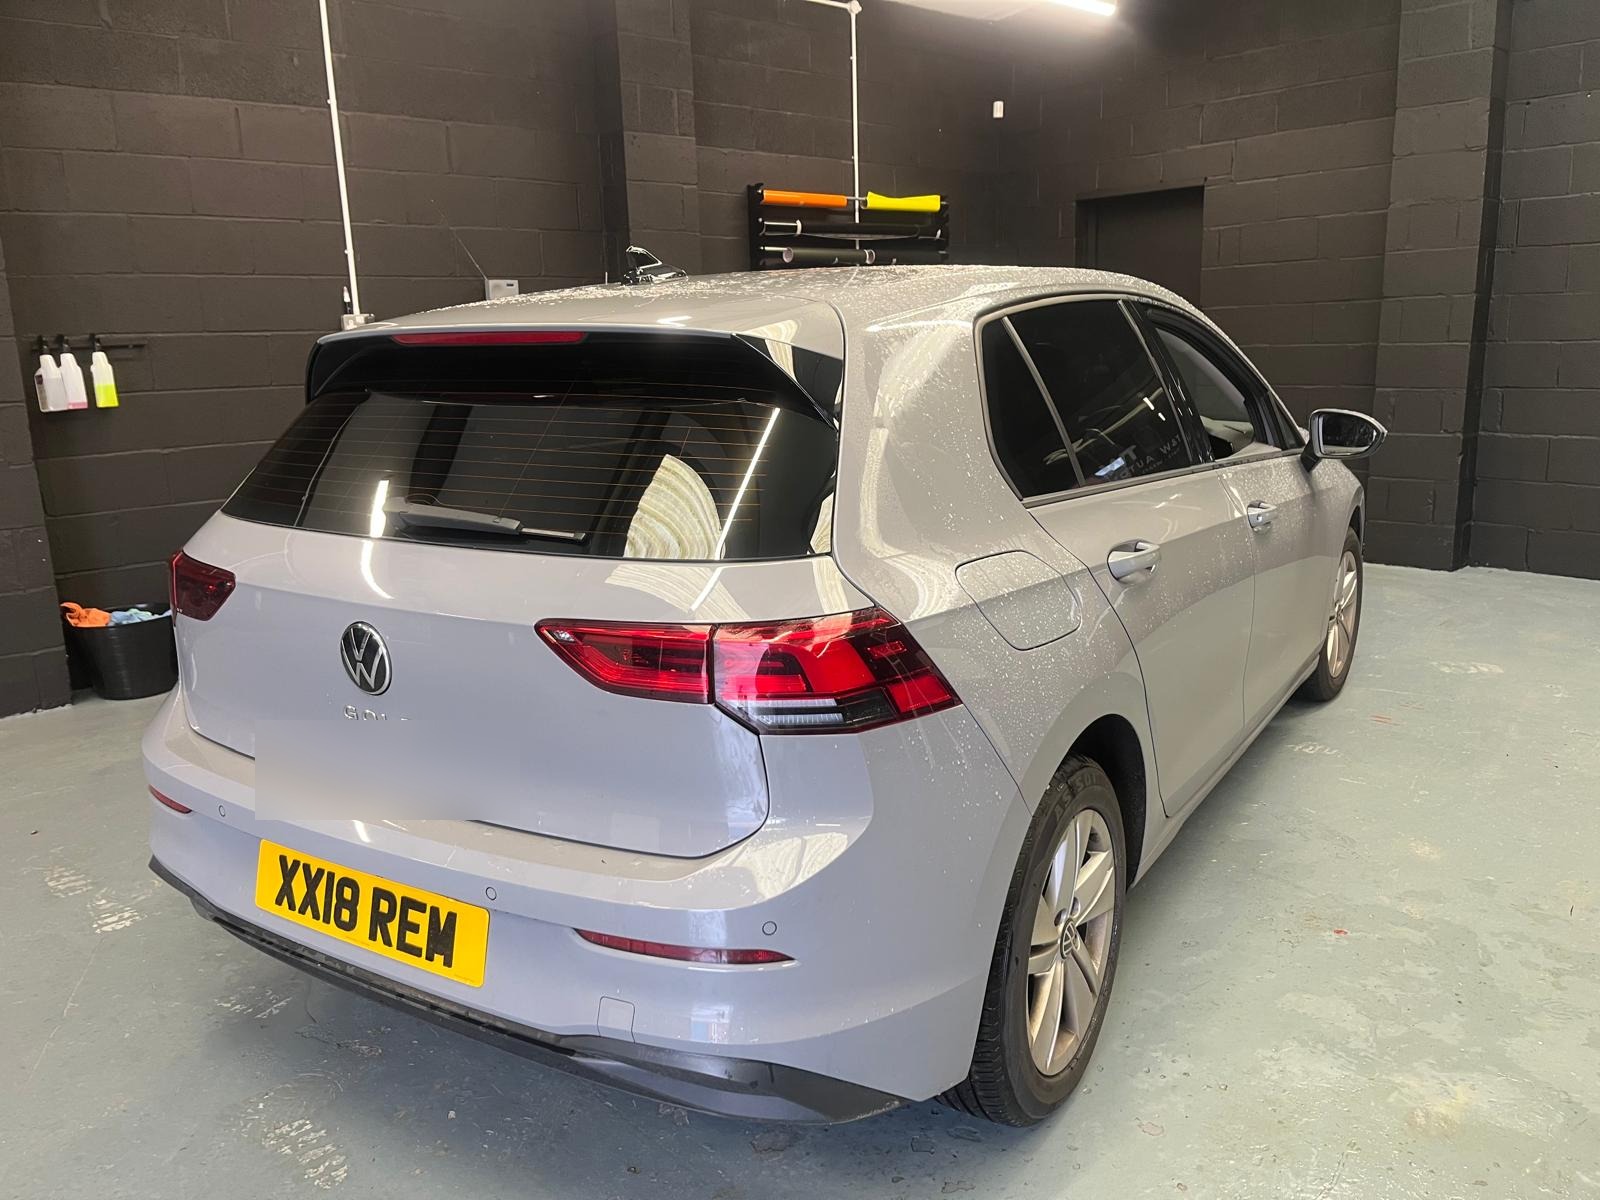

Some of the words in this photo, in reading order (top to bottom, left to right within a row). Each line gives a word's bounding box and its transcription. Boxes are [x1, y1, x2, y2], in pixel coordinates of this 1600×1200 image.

[341, 621, 392, 695] VW
[344, 705, 412, 720] GO
[275, 855, 360, 931] XX18
[368, 887, 457, 968] REM
